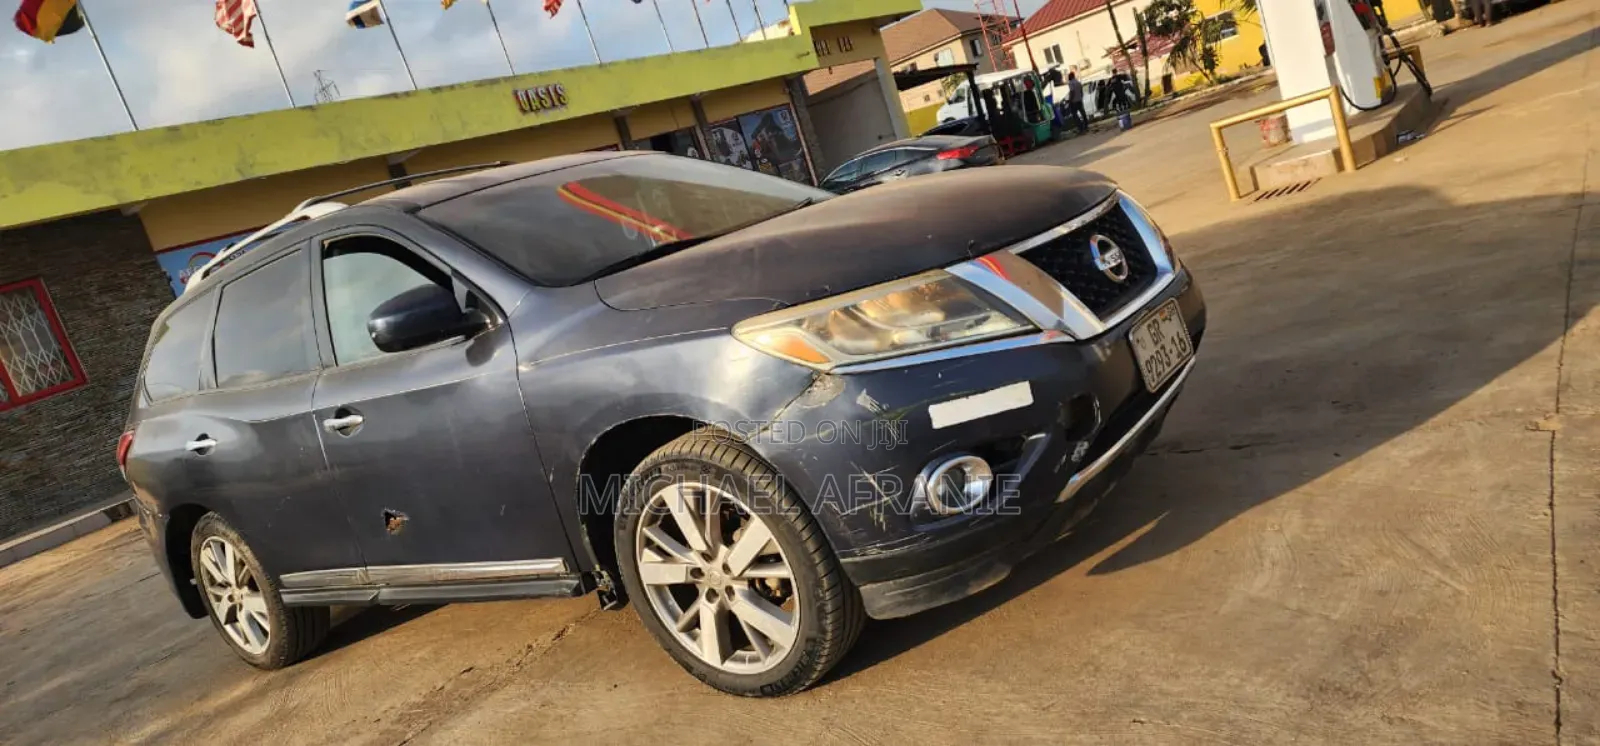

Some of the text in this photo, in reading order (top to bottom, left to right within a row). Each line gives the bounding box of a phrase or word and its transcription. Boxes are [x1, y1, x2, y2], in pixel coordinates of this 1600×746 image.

[513, 84, 568, 113] OASIS
[1147, 319, 1165, 345] GR
[1145, 331, 1187, 382] 9293-16
